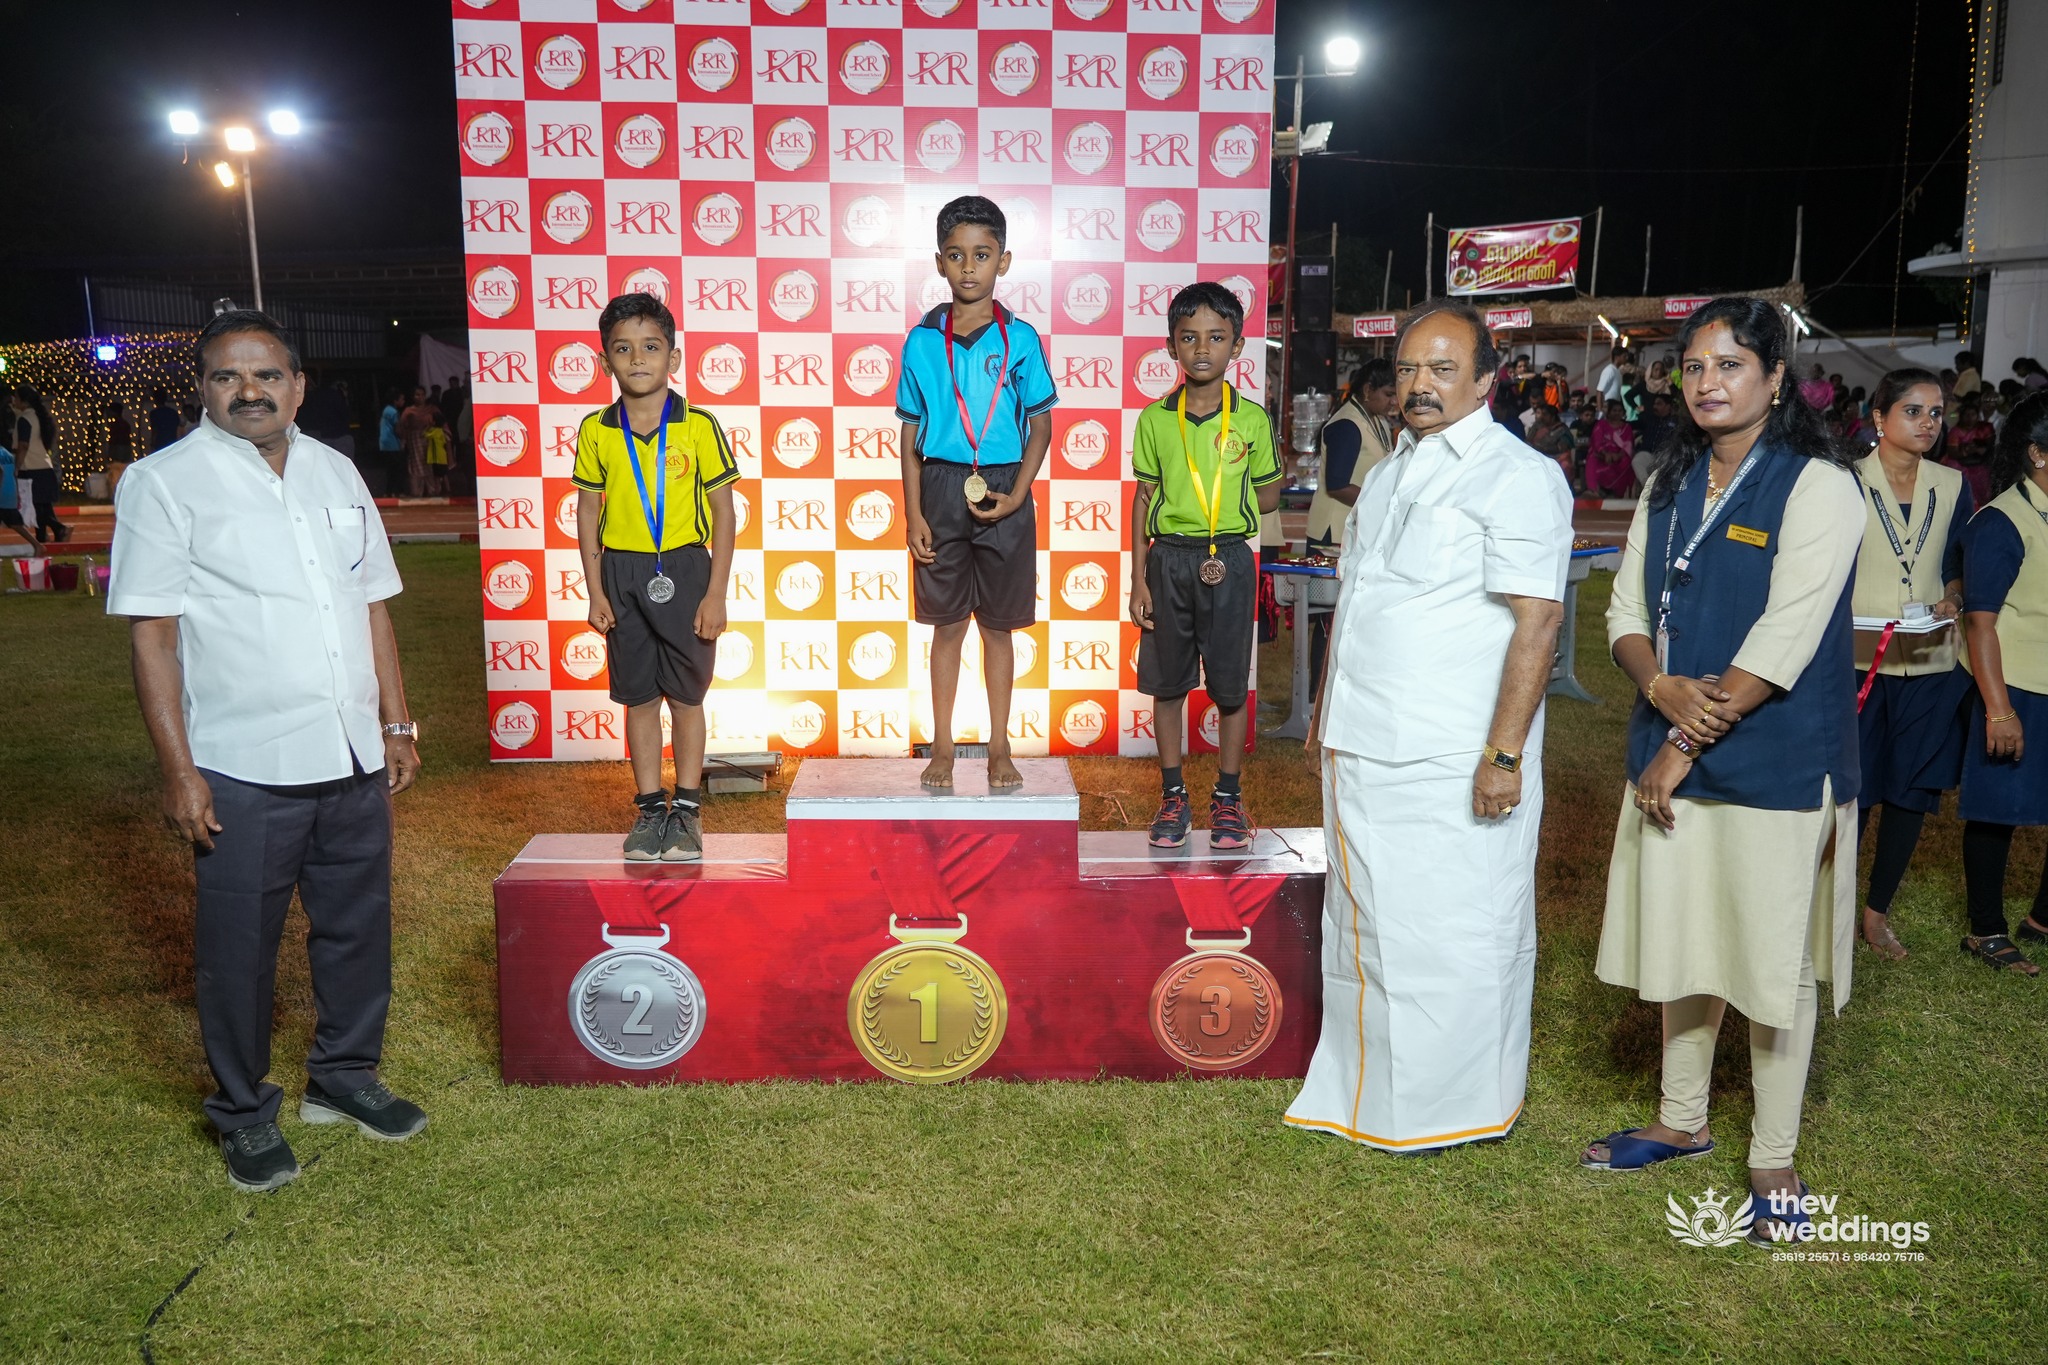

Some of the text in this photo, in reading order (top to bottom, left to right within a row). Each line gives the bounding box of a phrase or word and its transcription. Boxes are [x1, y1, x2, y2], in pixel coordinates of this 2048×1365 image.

[1356, 320, 1395, 333] CASHIER
[620, 985, 655, 1035] 2
[908, 982, 939, 1043] 1
[1200, 985, 1232, 1035] 3
